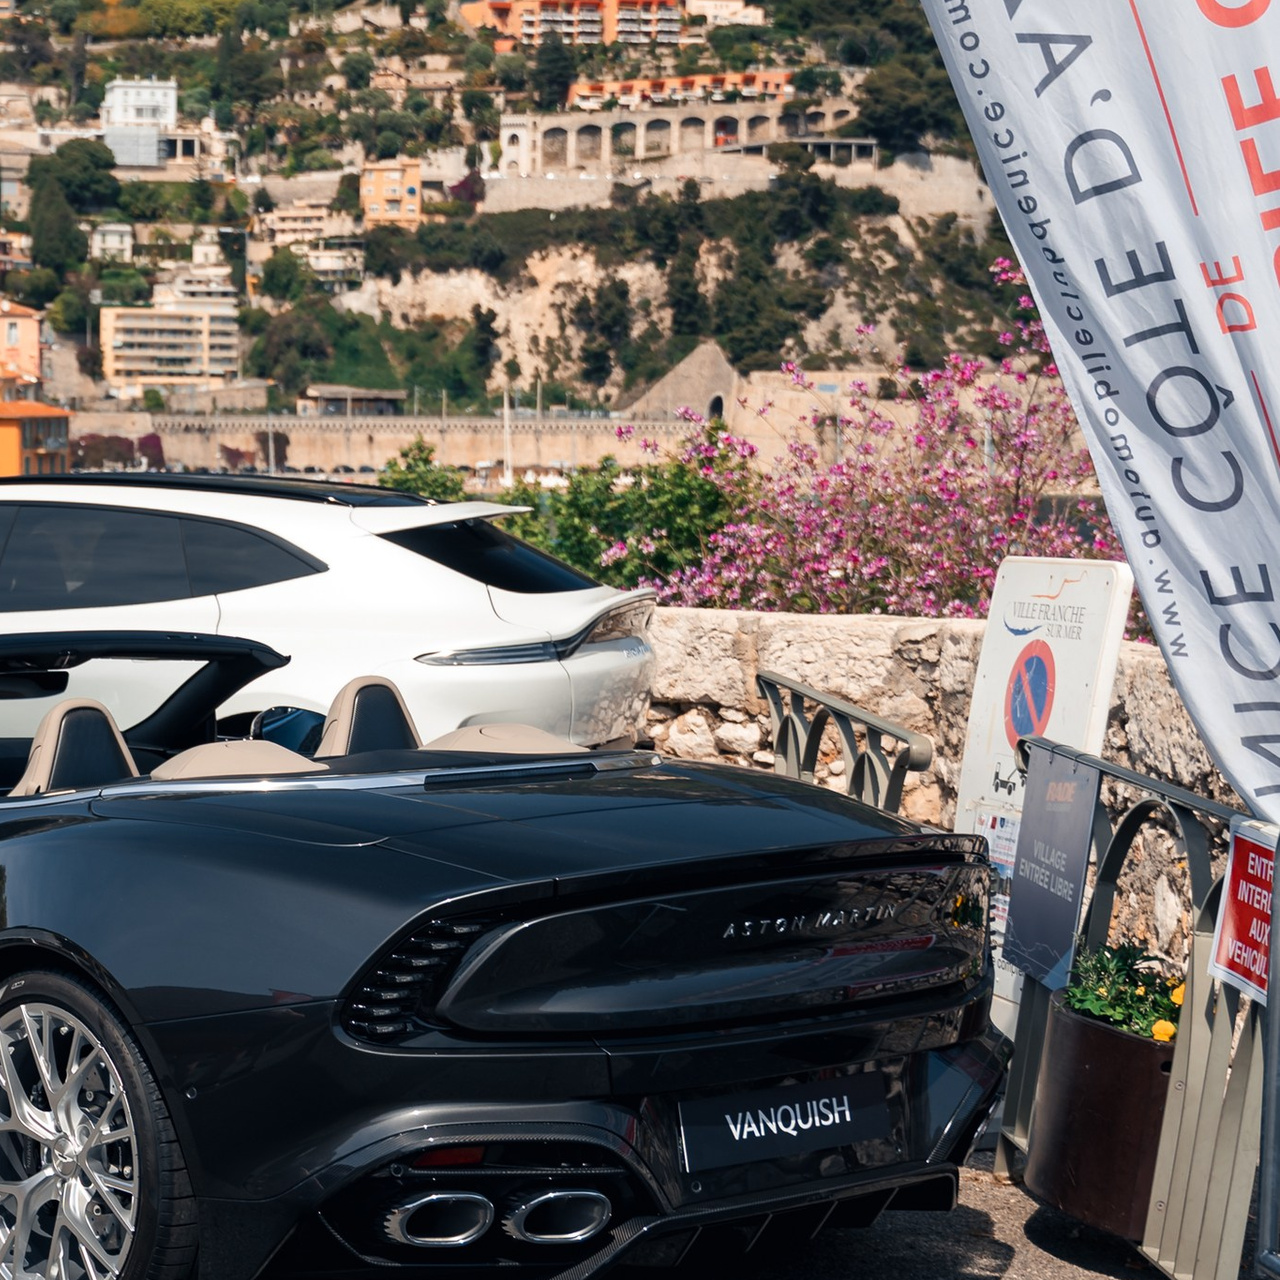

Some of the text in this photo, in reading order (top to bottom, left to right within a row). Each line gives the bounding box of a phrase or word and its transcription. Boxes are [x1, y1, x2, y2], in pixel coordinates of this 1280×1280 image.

[1045, 781, 1077, 802] RADE
[1033, 839, 1067, 872] VILLAGE
[1019, 857, 1074, 903] ENTRÉE LIBRE
[723, 904, 896, 939] ASTON MARTIN
[1248, 917, 1271, 947] AUX
[724, 1095, 852, 1141] VANQUISH
